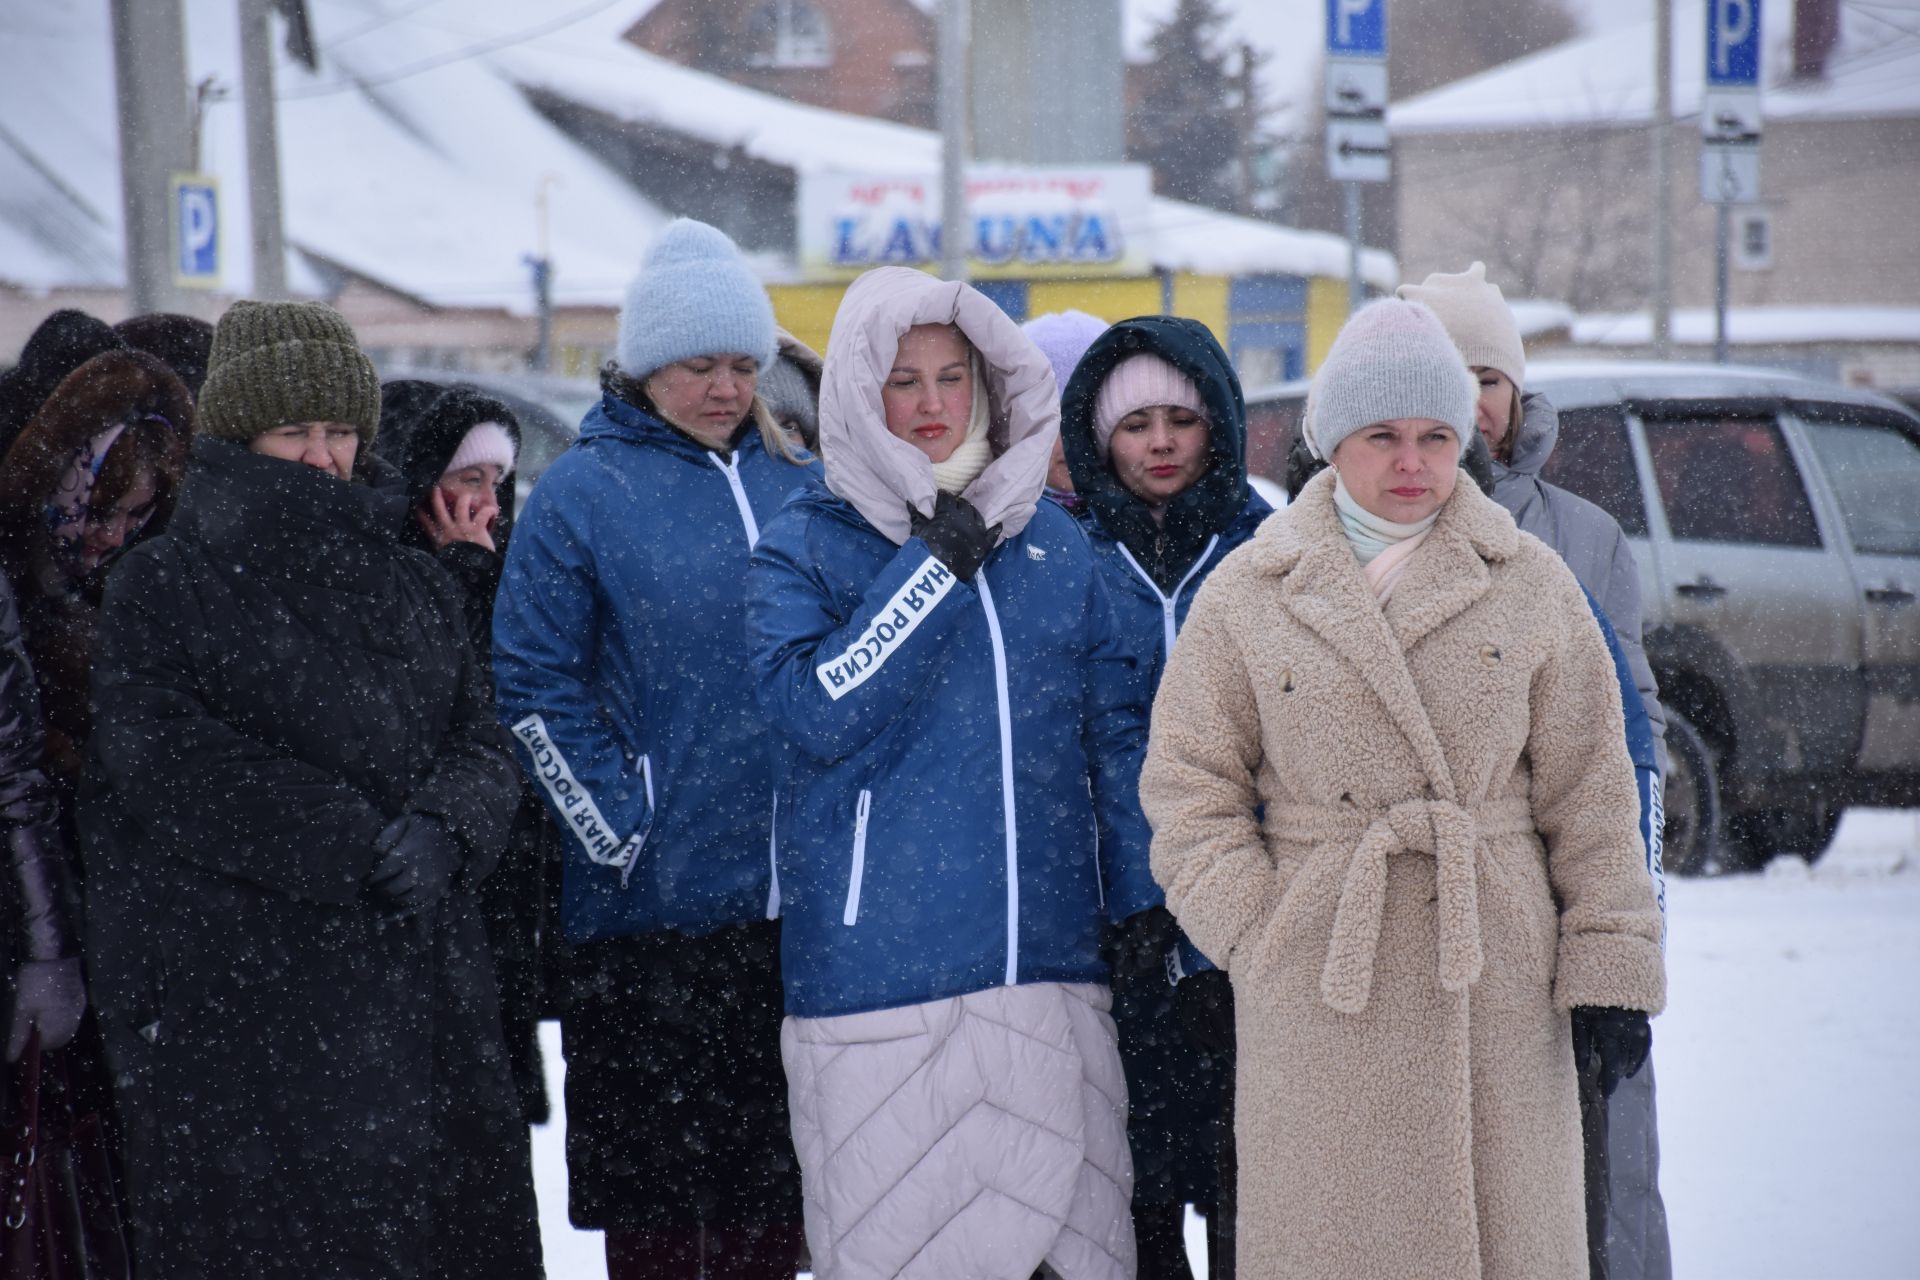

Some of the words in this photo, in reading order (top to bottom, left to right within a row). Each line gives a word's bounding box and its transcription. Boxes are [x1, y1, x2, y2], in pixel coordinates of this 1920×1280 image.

[1716, 0, 1750, 75] P
[181, 192, 214, 275] P
[825, 608, 910, 688] РОССИЯ
[520, 723, 583, 809] РОССИЯ
